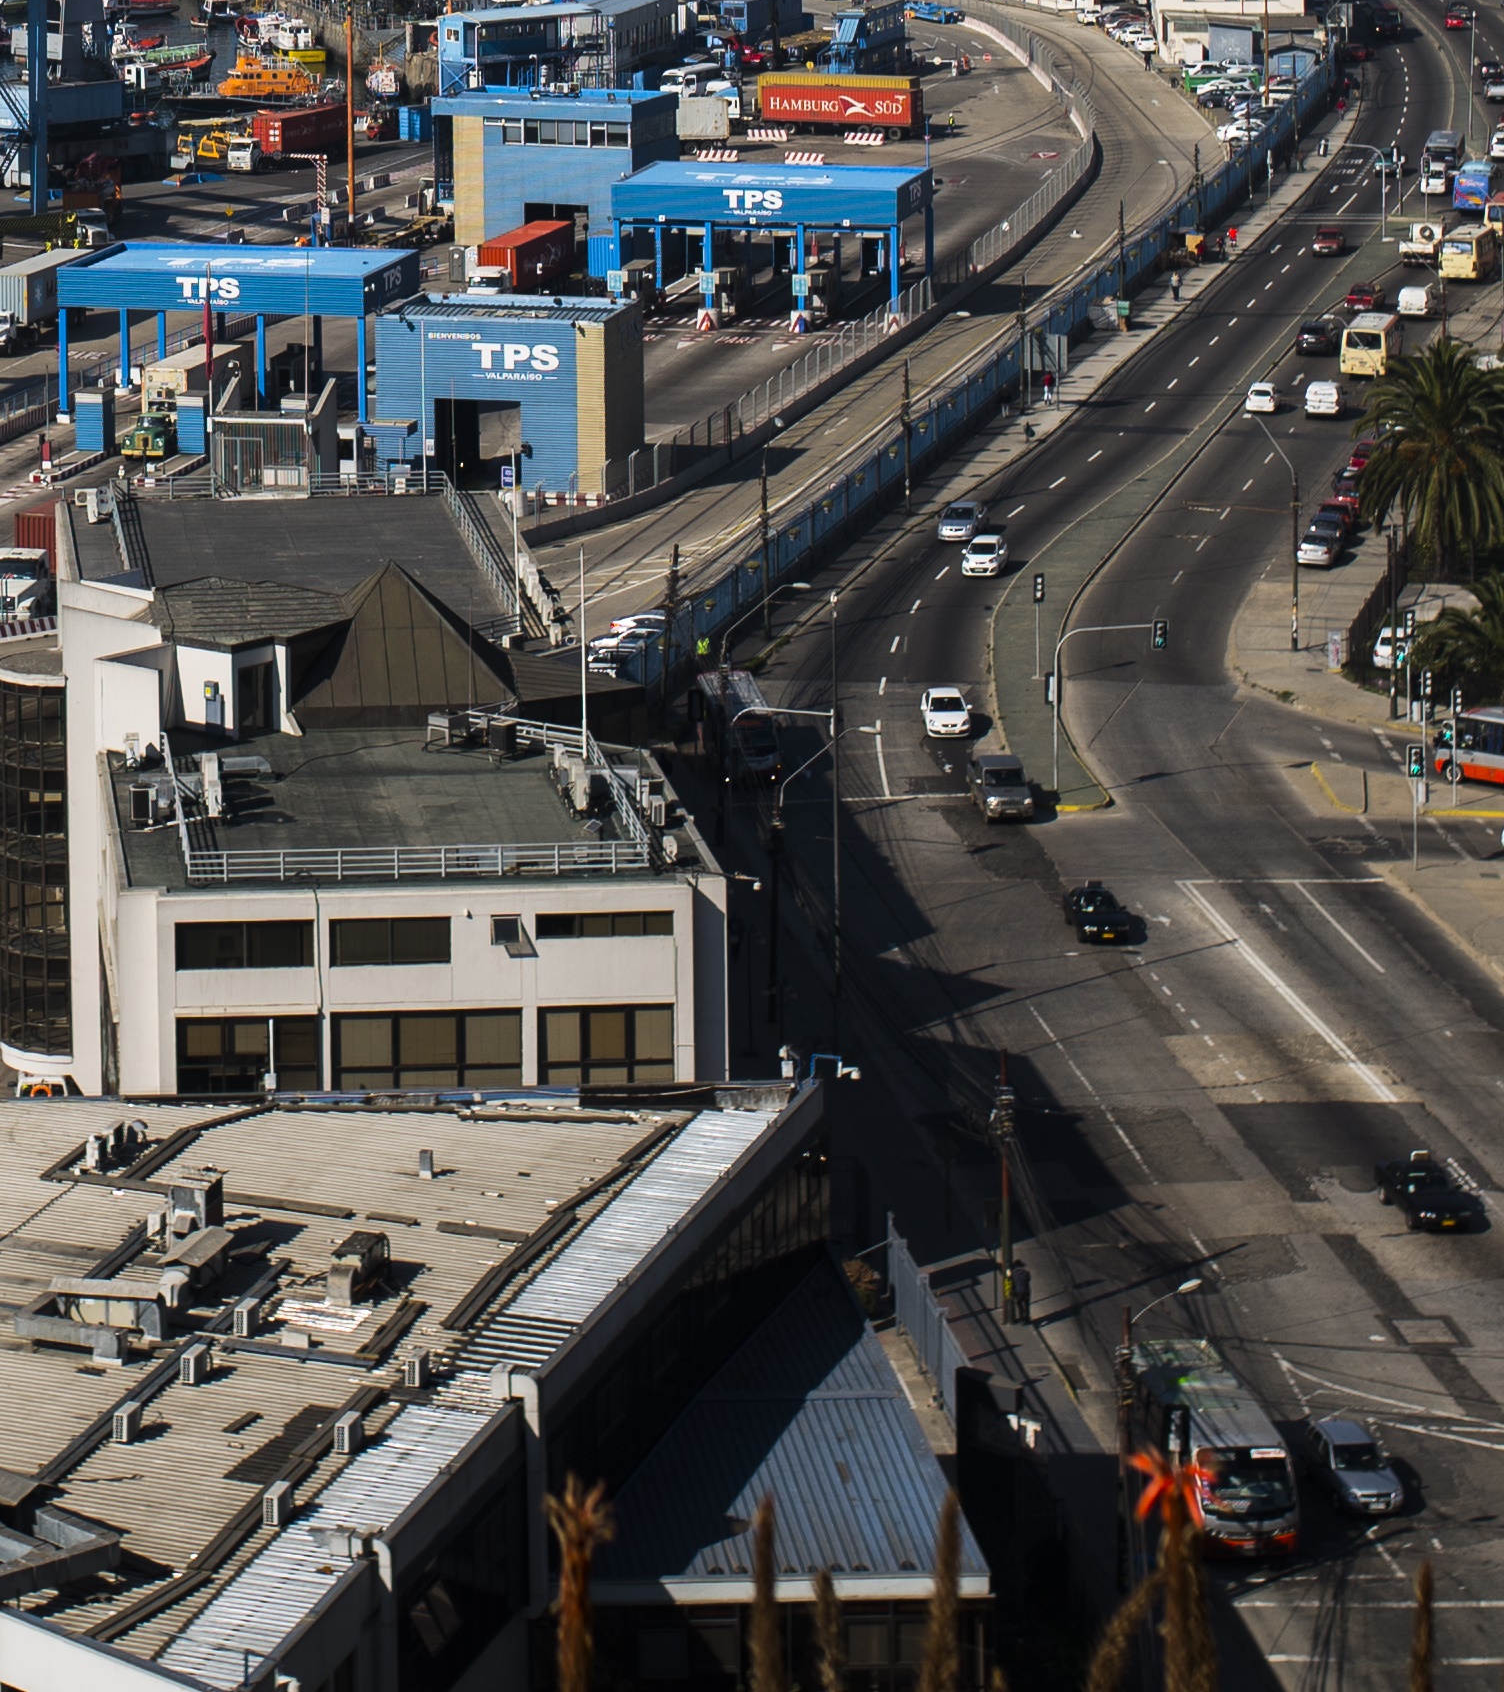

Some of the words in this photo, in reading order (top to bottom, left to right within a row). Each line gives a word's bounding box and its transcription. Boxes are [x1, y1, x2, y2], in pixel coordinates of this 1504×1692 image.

[770, 96, 839, 112] HAMBURG
[874, 99, 903, 115] SÜD
[723, 189, 784, 210] TPS
[909, 179, 922, 203] TPS
[175, 276, 240, 299] TPS
[383, 265, 402, 291] TPS
[428, 332, 481, 341] BIENVENIDOS
[471, 342, 560, 371] TPS
[485, 371, 543, 381] VALPARAÍSO
